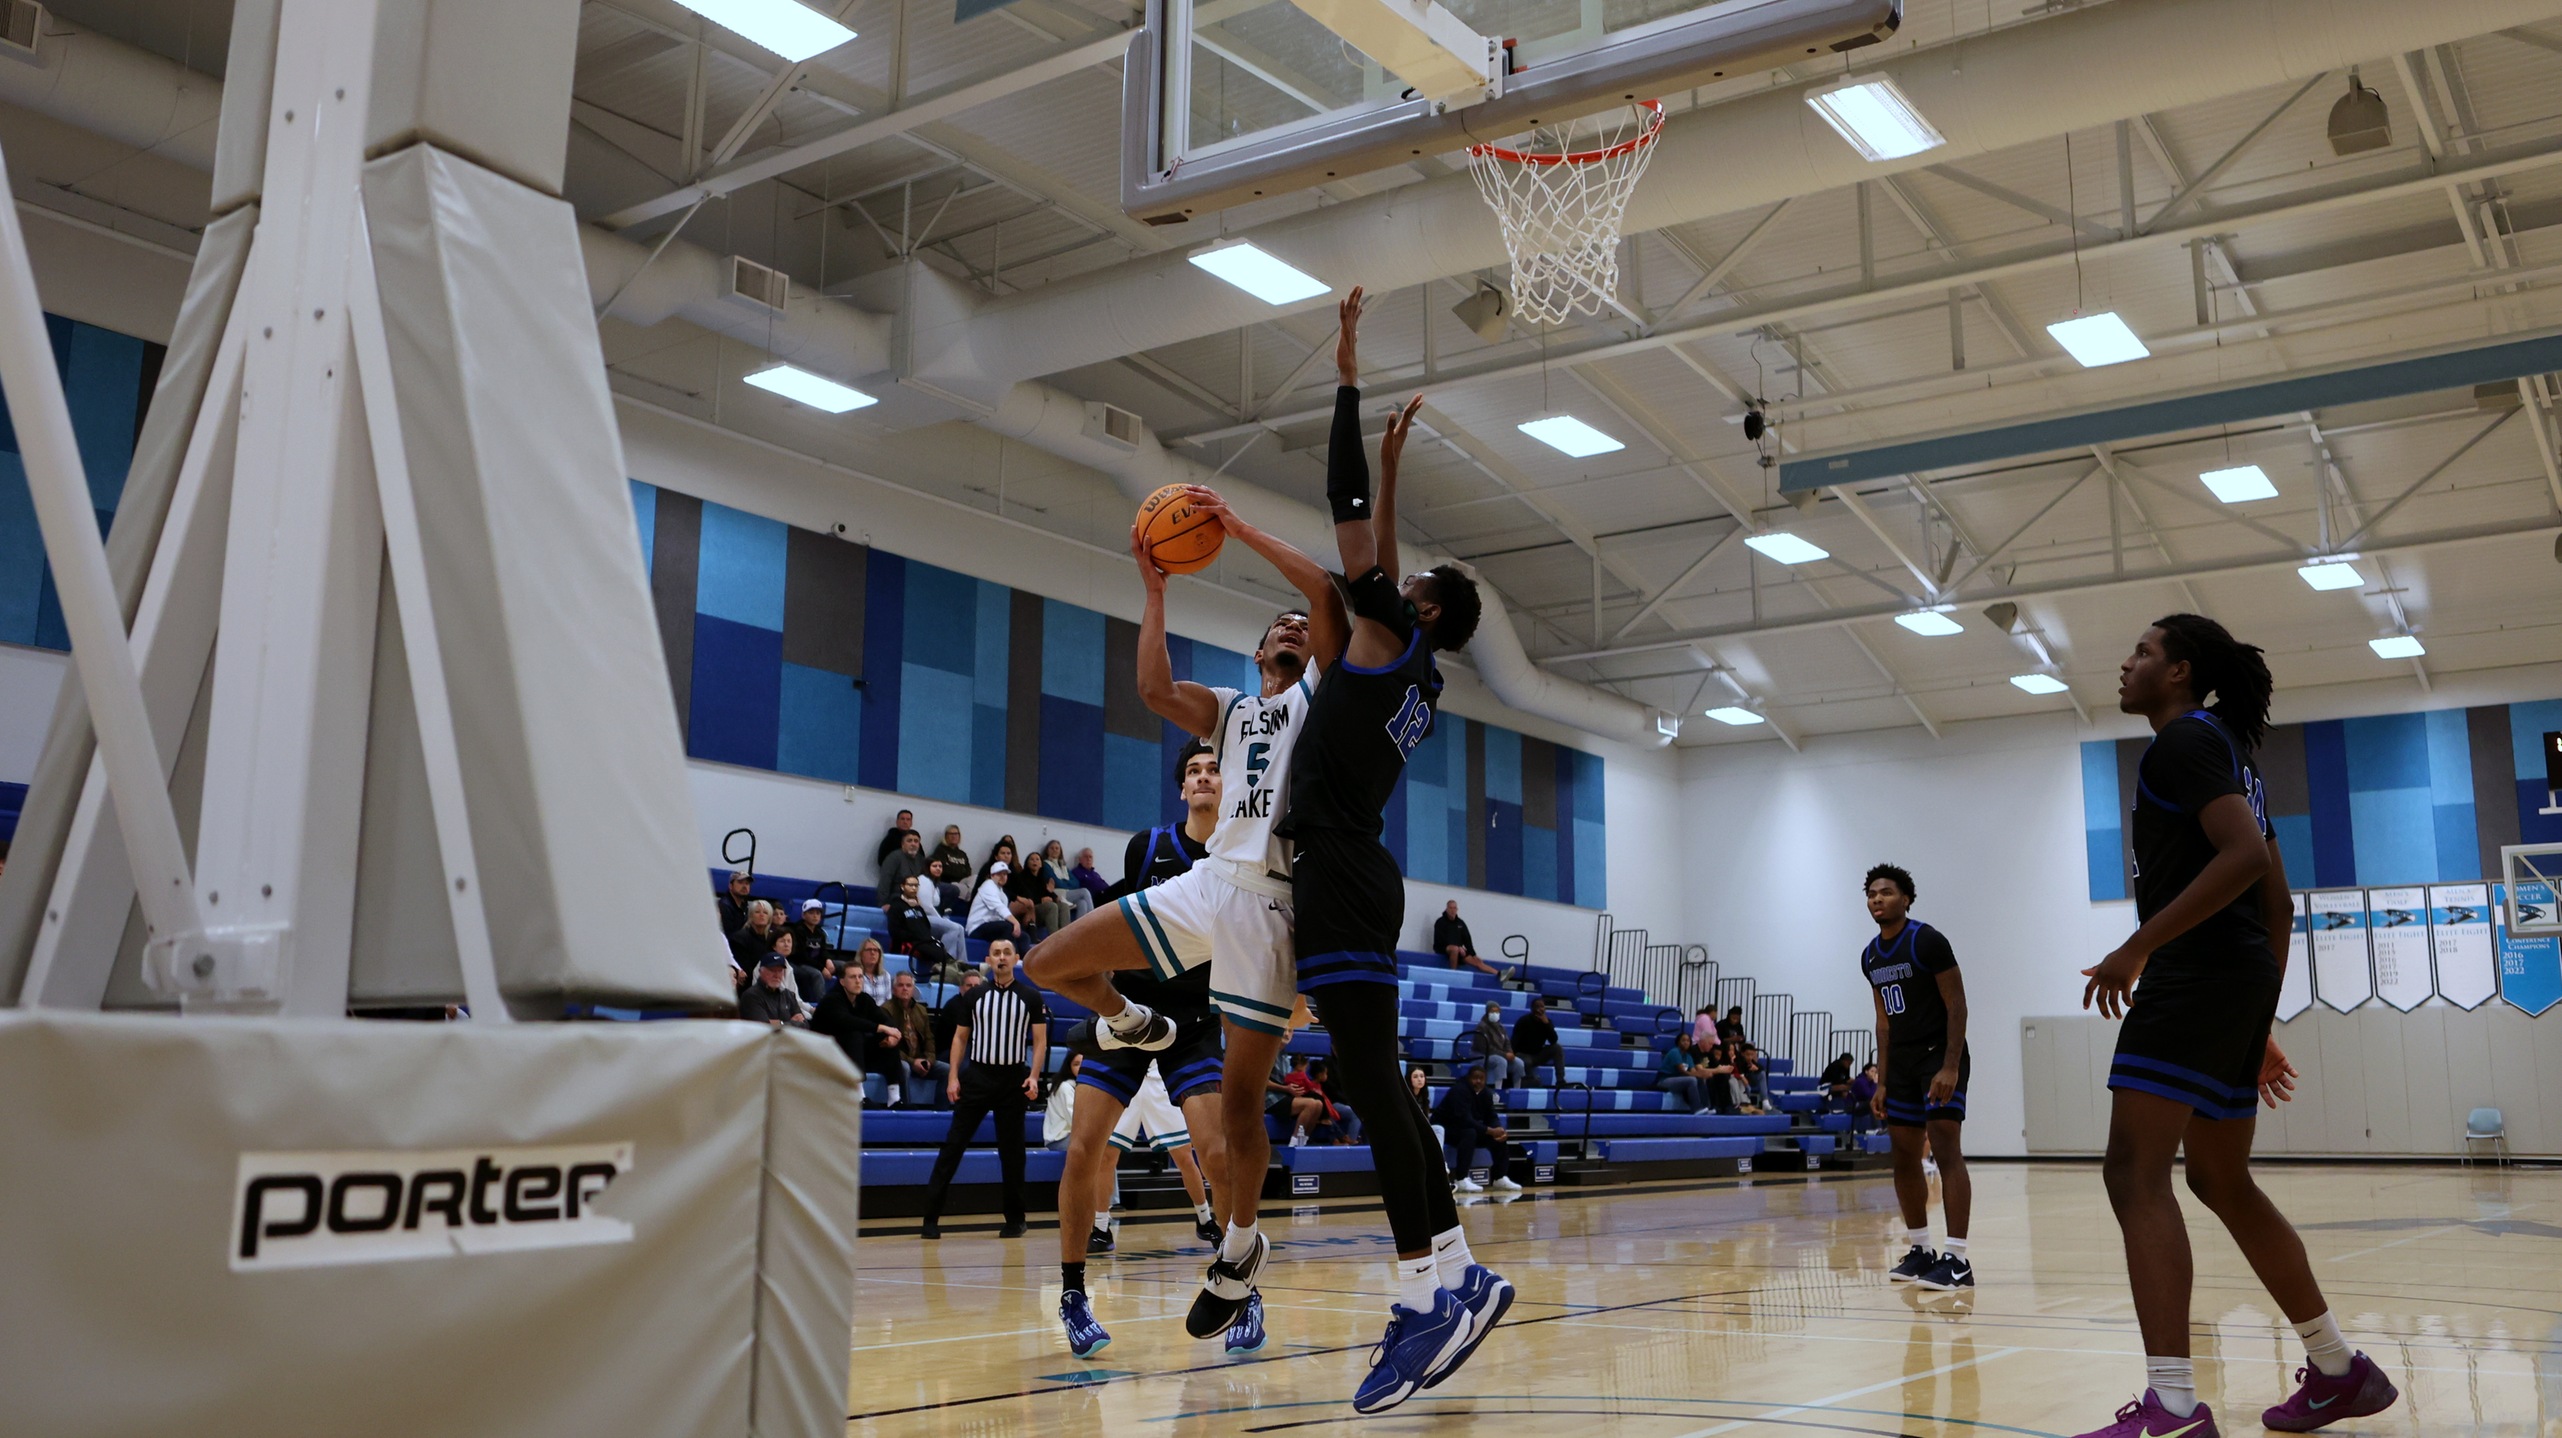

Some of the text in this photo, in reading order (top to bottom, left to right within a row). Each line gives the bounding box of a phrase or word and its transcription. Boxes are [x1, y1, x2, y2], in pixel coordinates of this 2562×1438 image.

[1385, 684, 1430, 762] 12
[1246, 742, 1271, 788] 5
[1230, 788, 1274, 819] AKE
[2503, 952, 2524, 960] 2016
[2503, 959, 2525, 967] 2017
[1869, 962, 1913, 986] MODESTO
[2503, 967, 2525, 975] 2022
[1881, 983, 1906, 1016] 10
